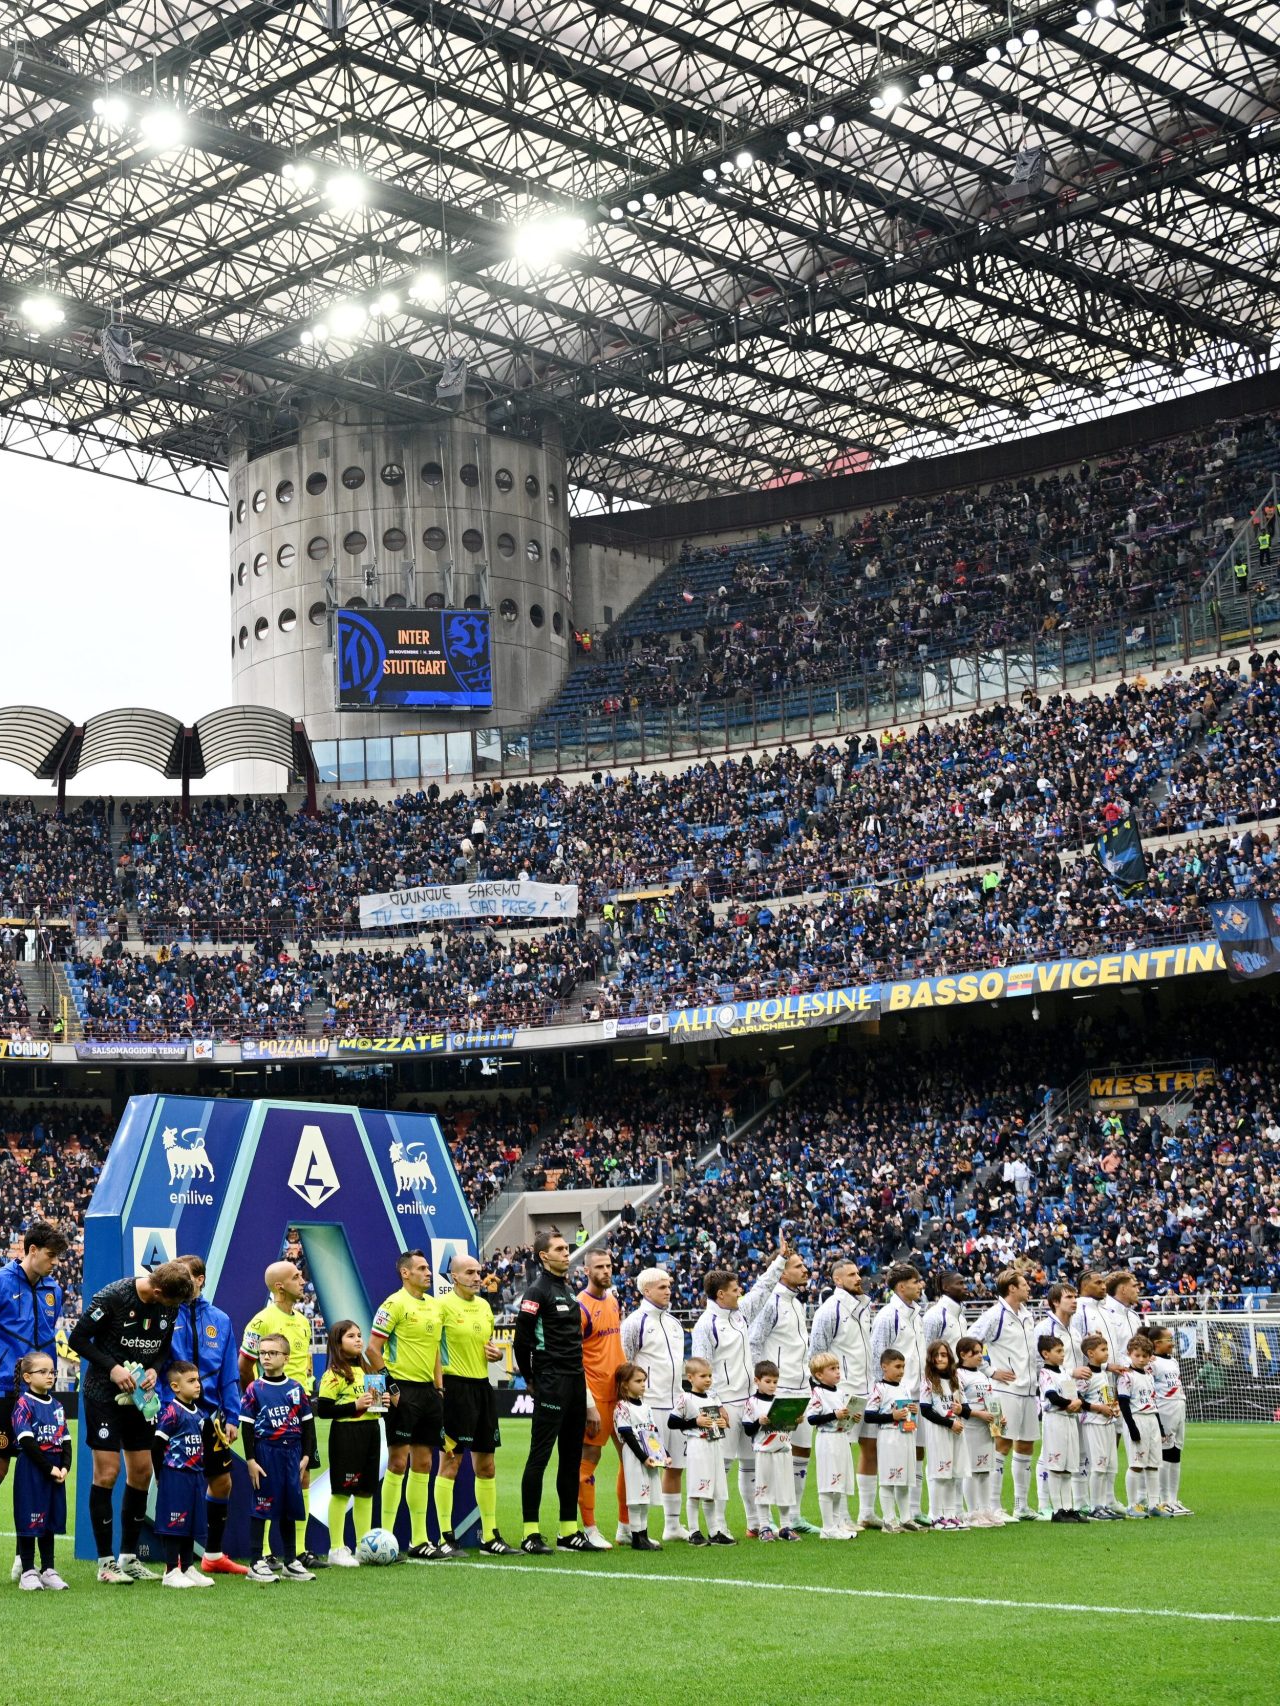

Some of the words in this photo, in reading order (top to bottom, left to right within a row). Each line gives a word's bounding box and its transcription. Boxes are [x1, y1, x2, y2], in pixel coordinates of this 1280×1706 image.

[398, 630, 430, 645] INTER
[382, 659, 447, 675] STUTTGART
[468, 883, 520, 899] SAREMO
[889, 971, 1003, 1011] BASSO
[745, 987, 872, 1025] POLESINE
[731, 1019, 806, 1035] BARUCHELLA
[7, 1041, 50, 1056] TORINO
[259, 1038, 329, 1056] POZZALLO
[339, 1033, 444, 1052] MOZZATE
[91, 1046, 157, 1055] SALSOMAGGIORE
[158, 1046, 185, 1055] TERME
[169, 1190, 214, 1206] enilive
[396, 1201, 436, 1216] enilive
[120, 1336, 162, 1349] betsson
[140, 1347, 159, 1355] .sport
[267, 1405, 291, 1418] KEEP
[38, 1424, 57, 1435] KEEP
[184, 1434, 202, 1445] KEE
